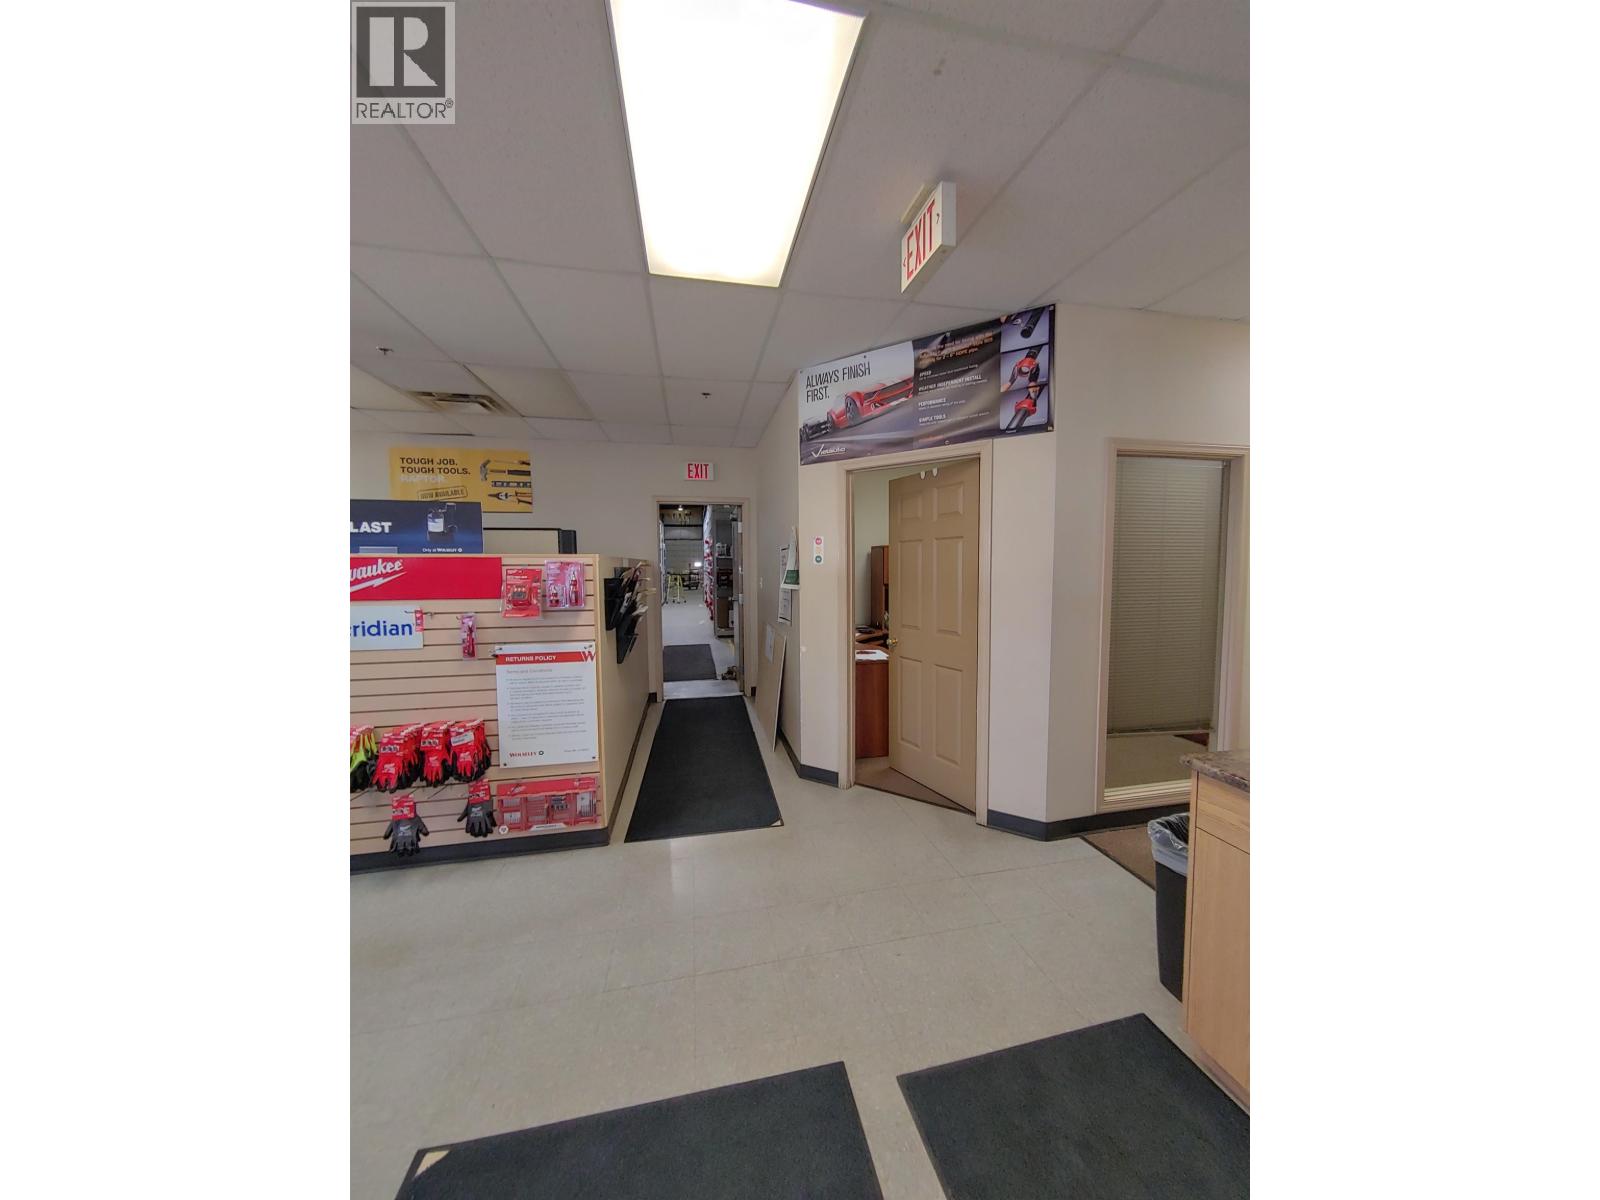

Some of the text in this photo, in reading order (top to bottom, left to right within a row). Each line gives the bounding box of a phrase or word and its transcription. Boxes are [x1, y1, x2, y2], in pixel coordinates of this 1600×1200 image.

[907, 198, 935, 281] EXIT
[806, 361, 871, 390] ALWAYS FINISH
[806, 385, 830, 403] FIRST.
[400, 457, 458, 466] TOUGH JOB.
[400, 466, 471, 475] TOUGH TOOLS.
[687, 463, 709, 480] EXIT
[434, 489, 465, 498] AVAILABLE
[350, 521, 392, 533] LAST
[350, 620, 413, 637] ridian
